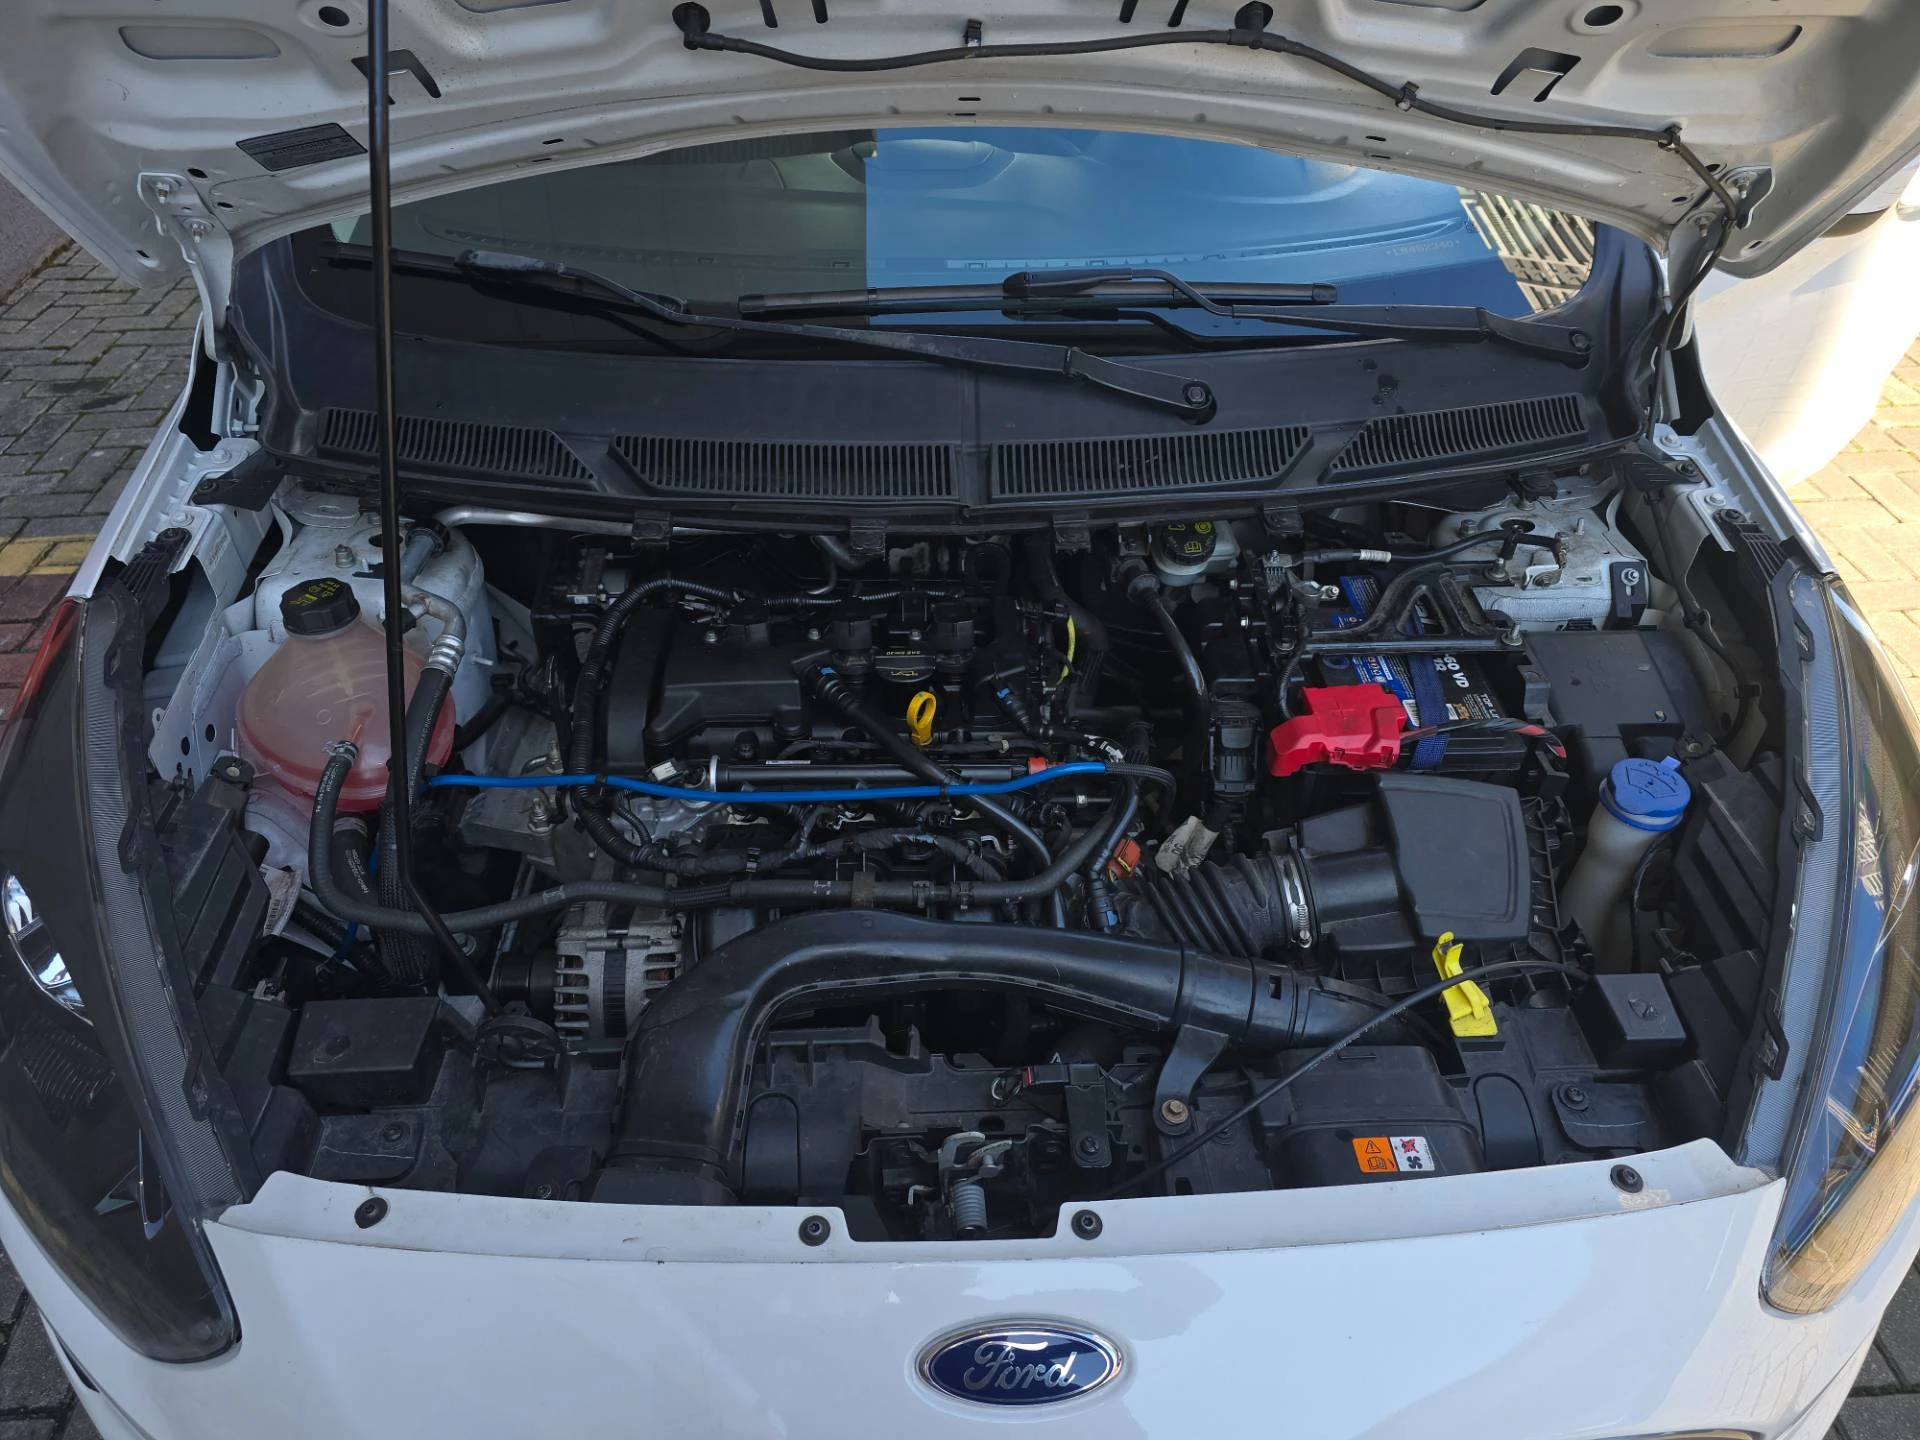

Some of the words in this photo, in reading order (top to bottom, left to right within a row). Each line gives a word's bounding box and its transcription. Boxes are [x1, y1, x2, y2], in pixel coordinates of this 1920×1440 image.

[1452, 672, 1470, 688] VD
[1480, 693, 1494, 708] TOP
[963, 1340, 1077, 1391] Ford
